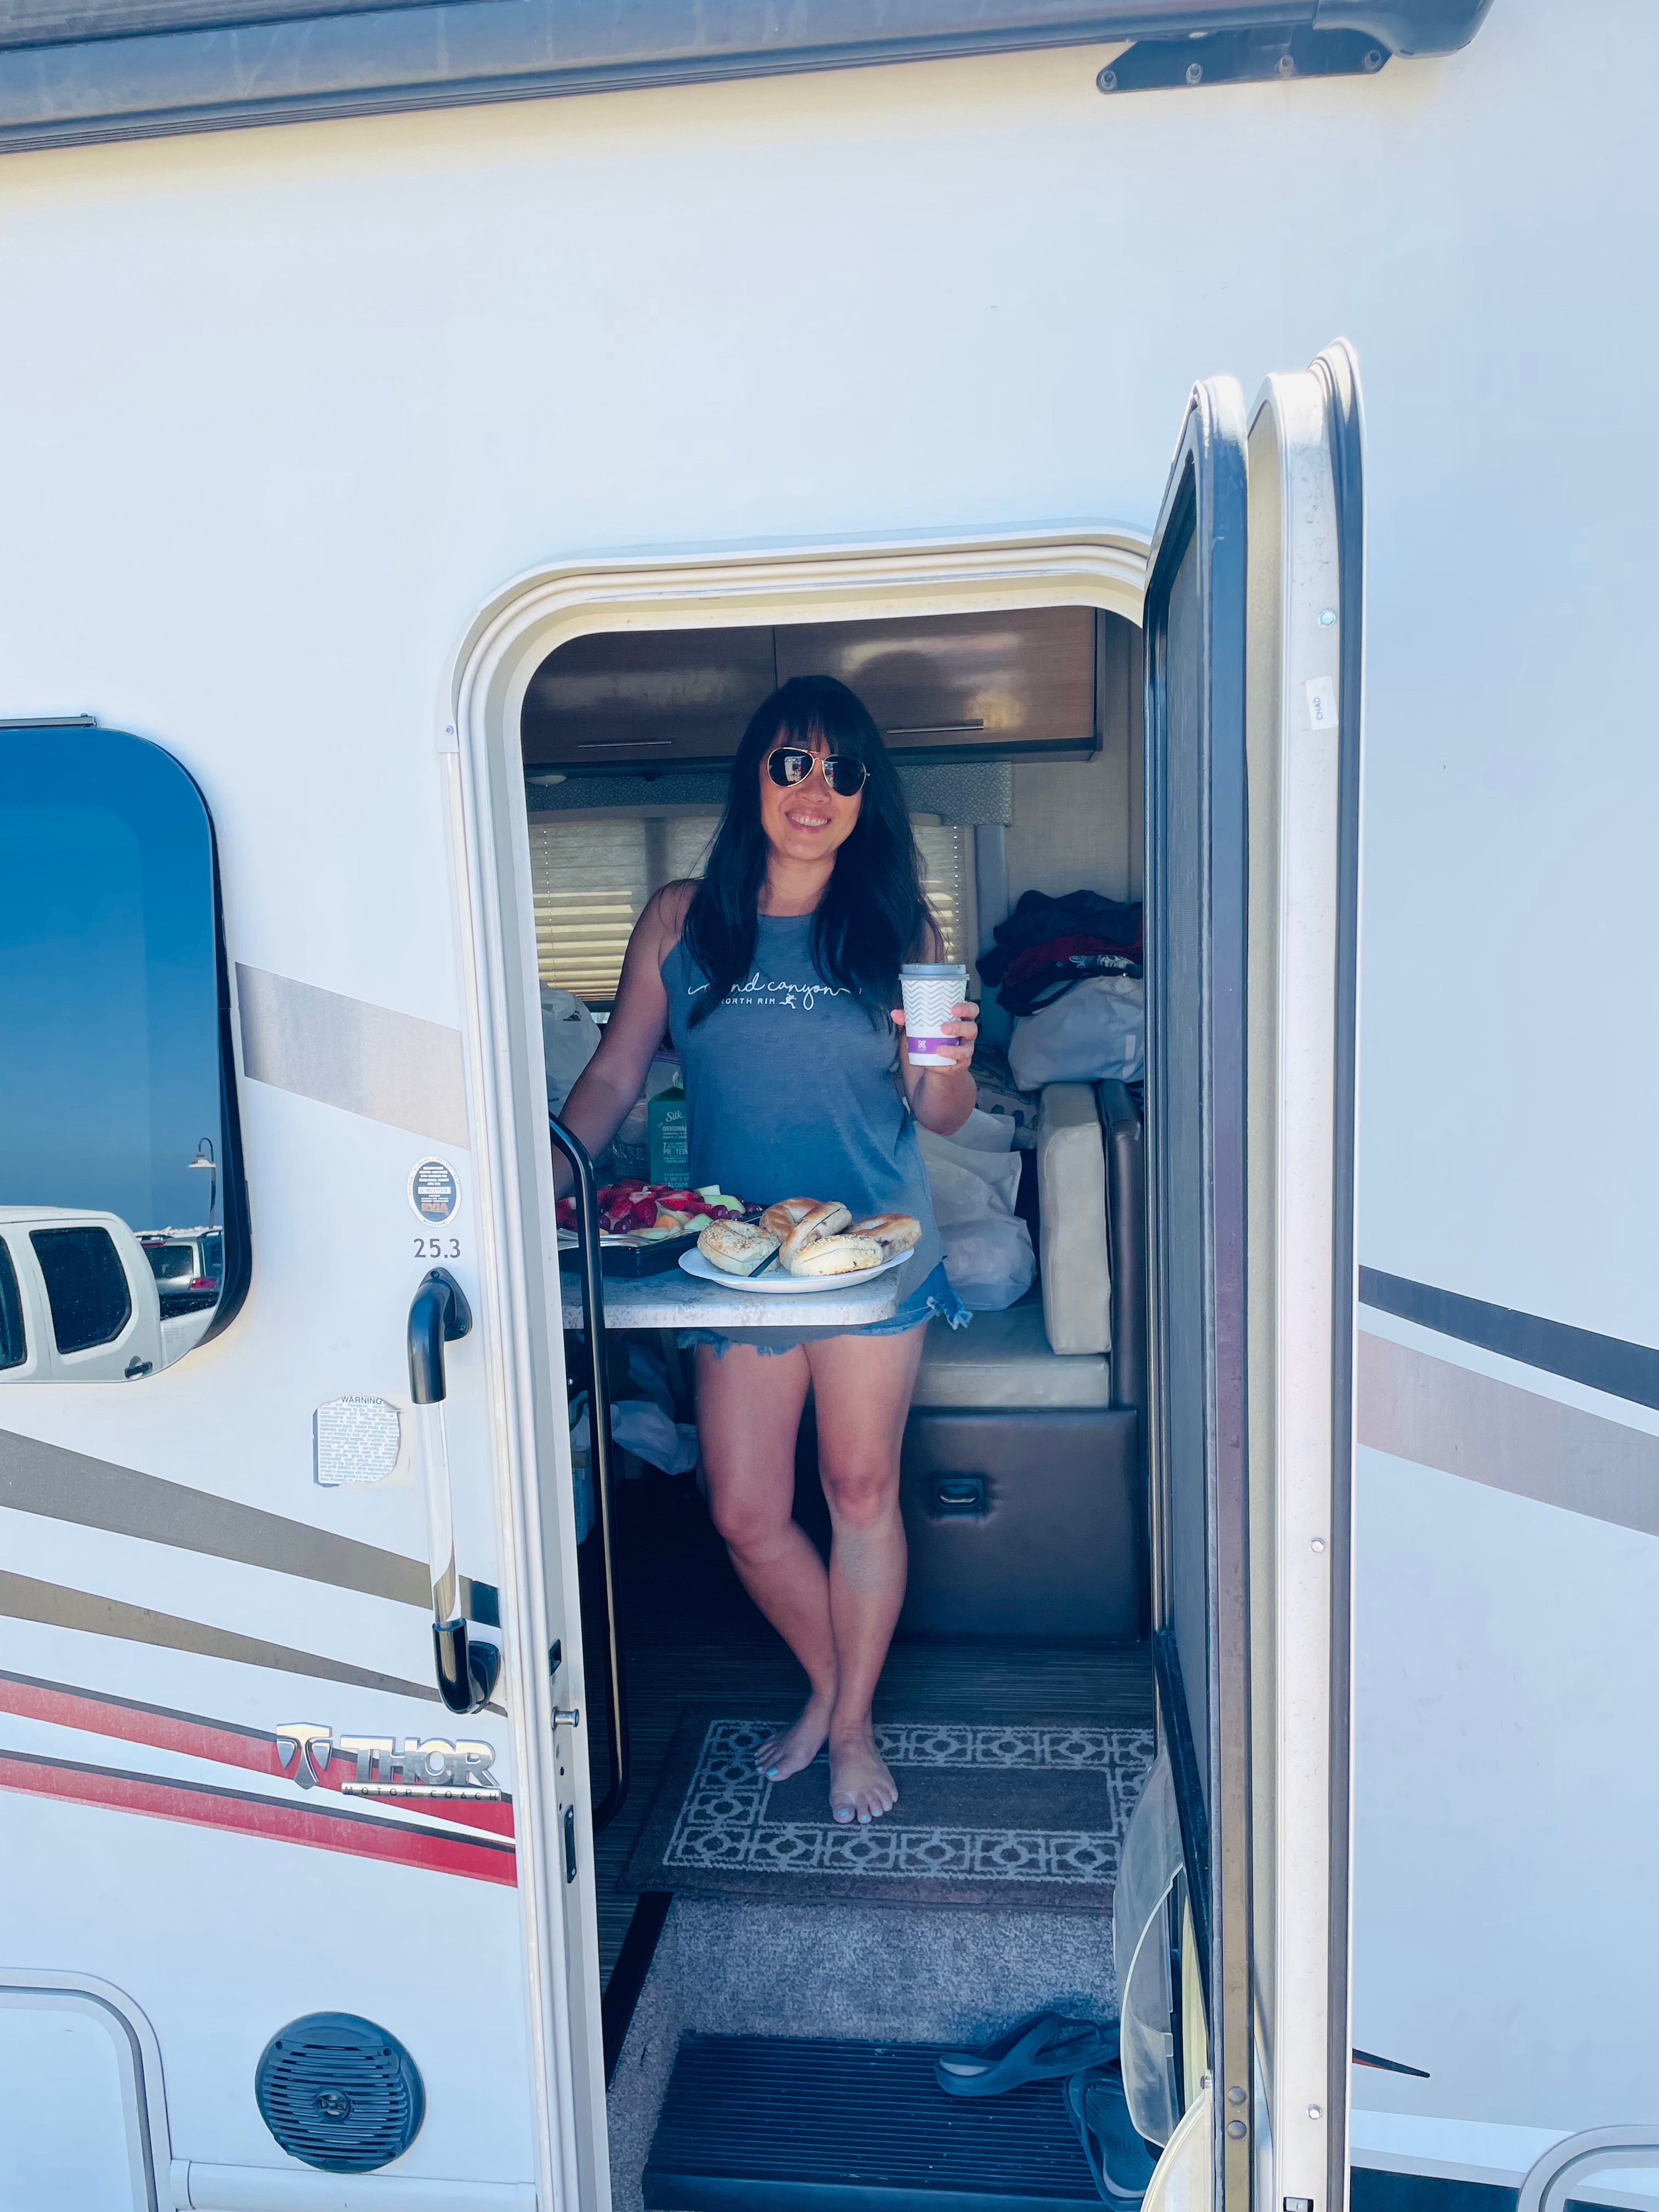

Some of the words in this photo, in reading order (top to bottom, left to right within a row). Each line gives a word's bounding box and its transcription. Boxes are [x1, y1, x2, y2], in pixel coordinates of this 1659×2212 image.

[768, 981, 851, 1011] canyon
[665, 1110, 683, 1122] Silk
[414, 1238, 460, 1258] 25.3
[341, 1396, 382, 1404] WARNING
[340, 1735, 500, 1787] THOR
[344, 1786, 413, 1797] MOTOR
[430, 1790, 498, 1801] COACH
